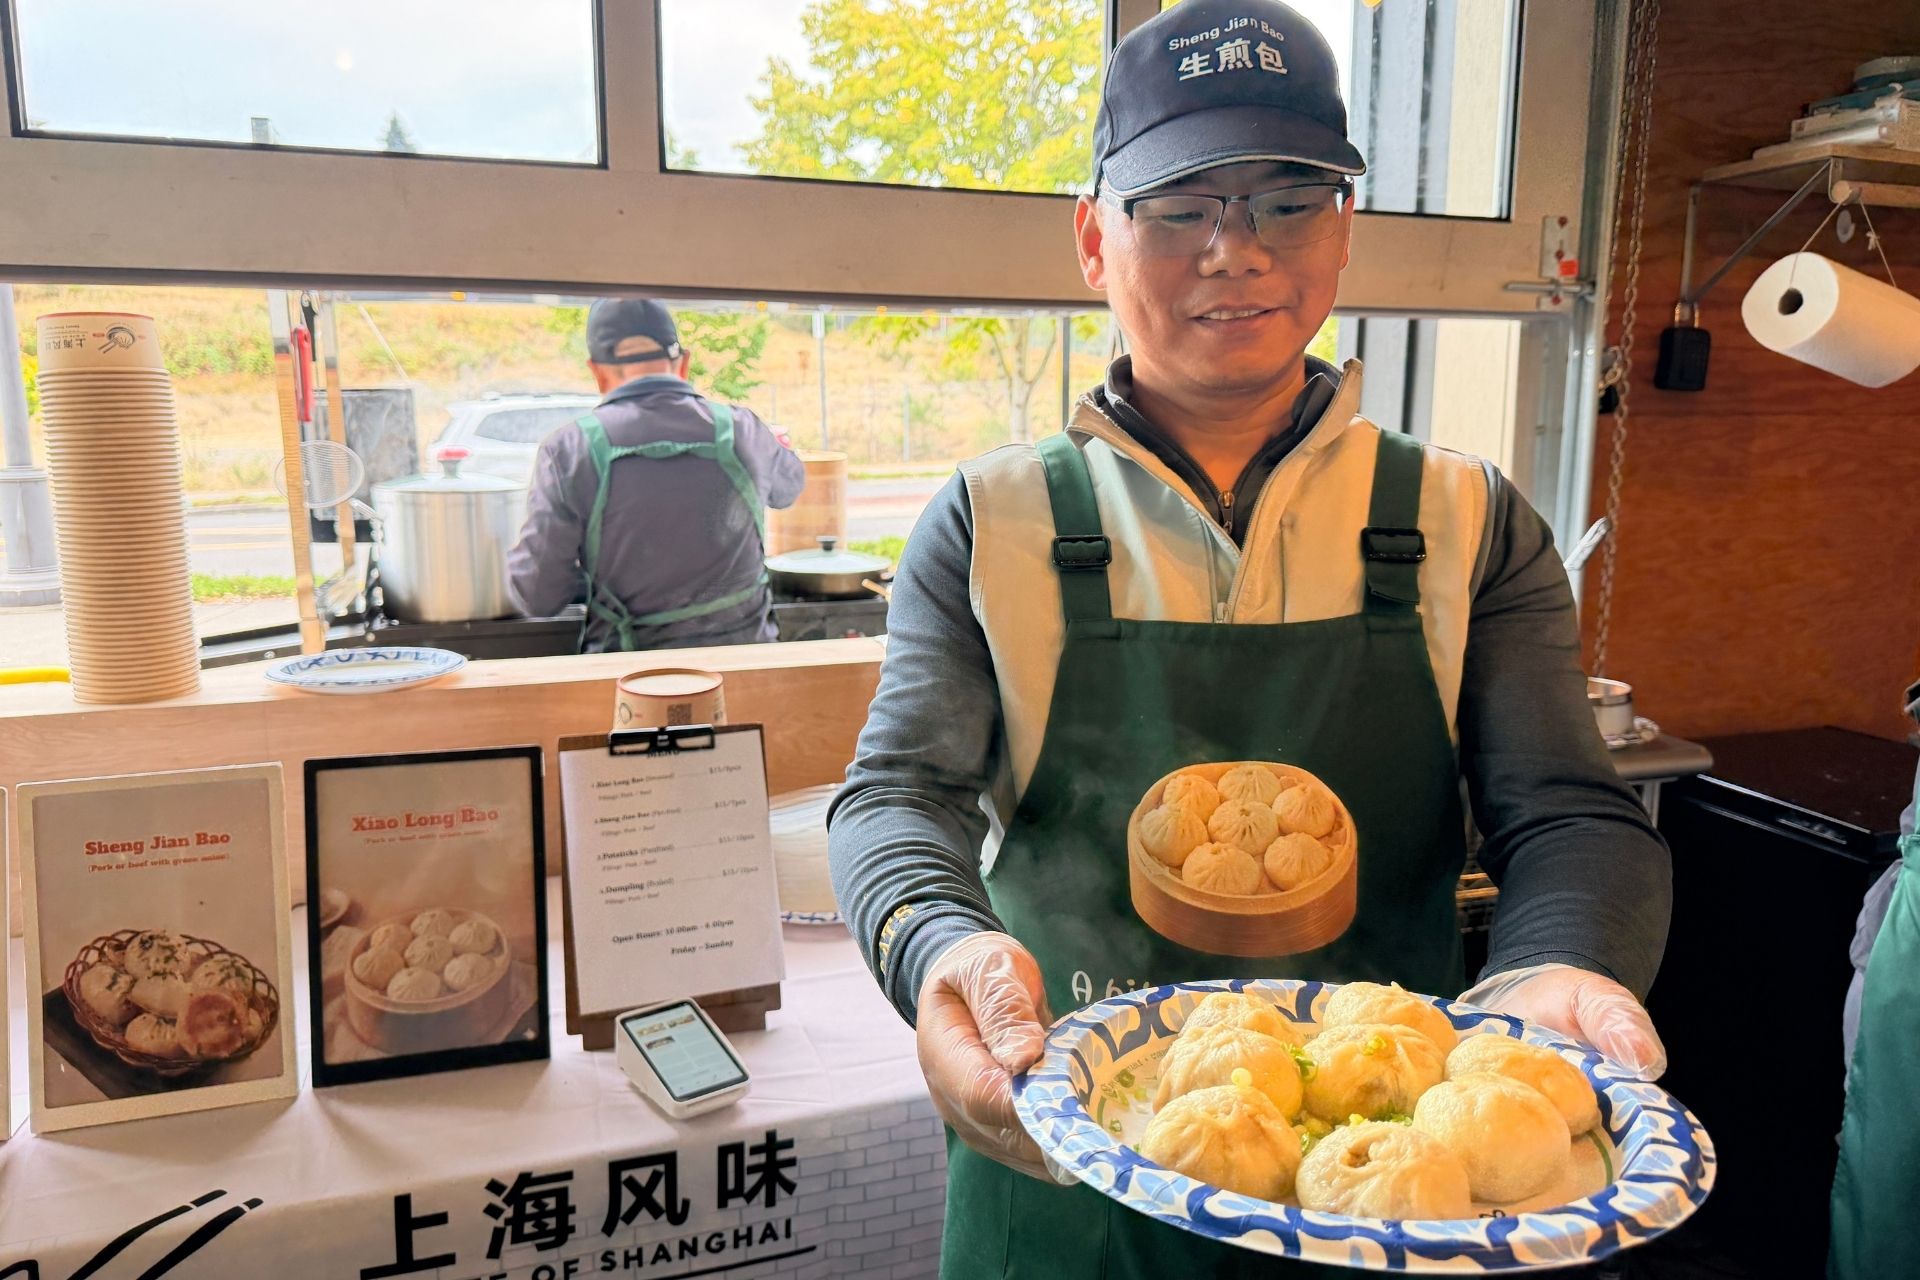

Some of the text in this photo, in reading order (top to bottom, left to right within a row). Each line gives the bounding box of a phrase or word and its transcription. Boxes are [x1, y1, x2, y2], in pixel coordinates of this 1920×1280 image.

[1168, 17, 1285, 51] Sheng Jian Bao
[1178, 37, 1288, 81] 生煎包
[352, 807, 499, 832] Xiao Long Bao
[85, 832, 231, 856] Sheng Jian Bao
[151, 858, 170, 867] with
[612, 934, 634, 944] Open
[671, 944, 696, 955] Friday
[705, 939, 734, 950] Sunday
[360, 1129, 797, 1280] 上海风味
[600, 1218, 793, 1272] SHANGHAI
